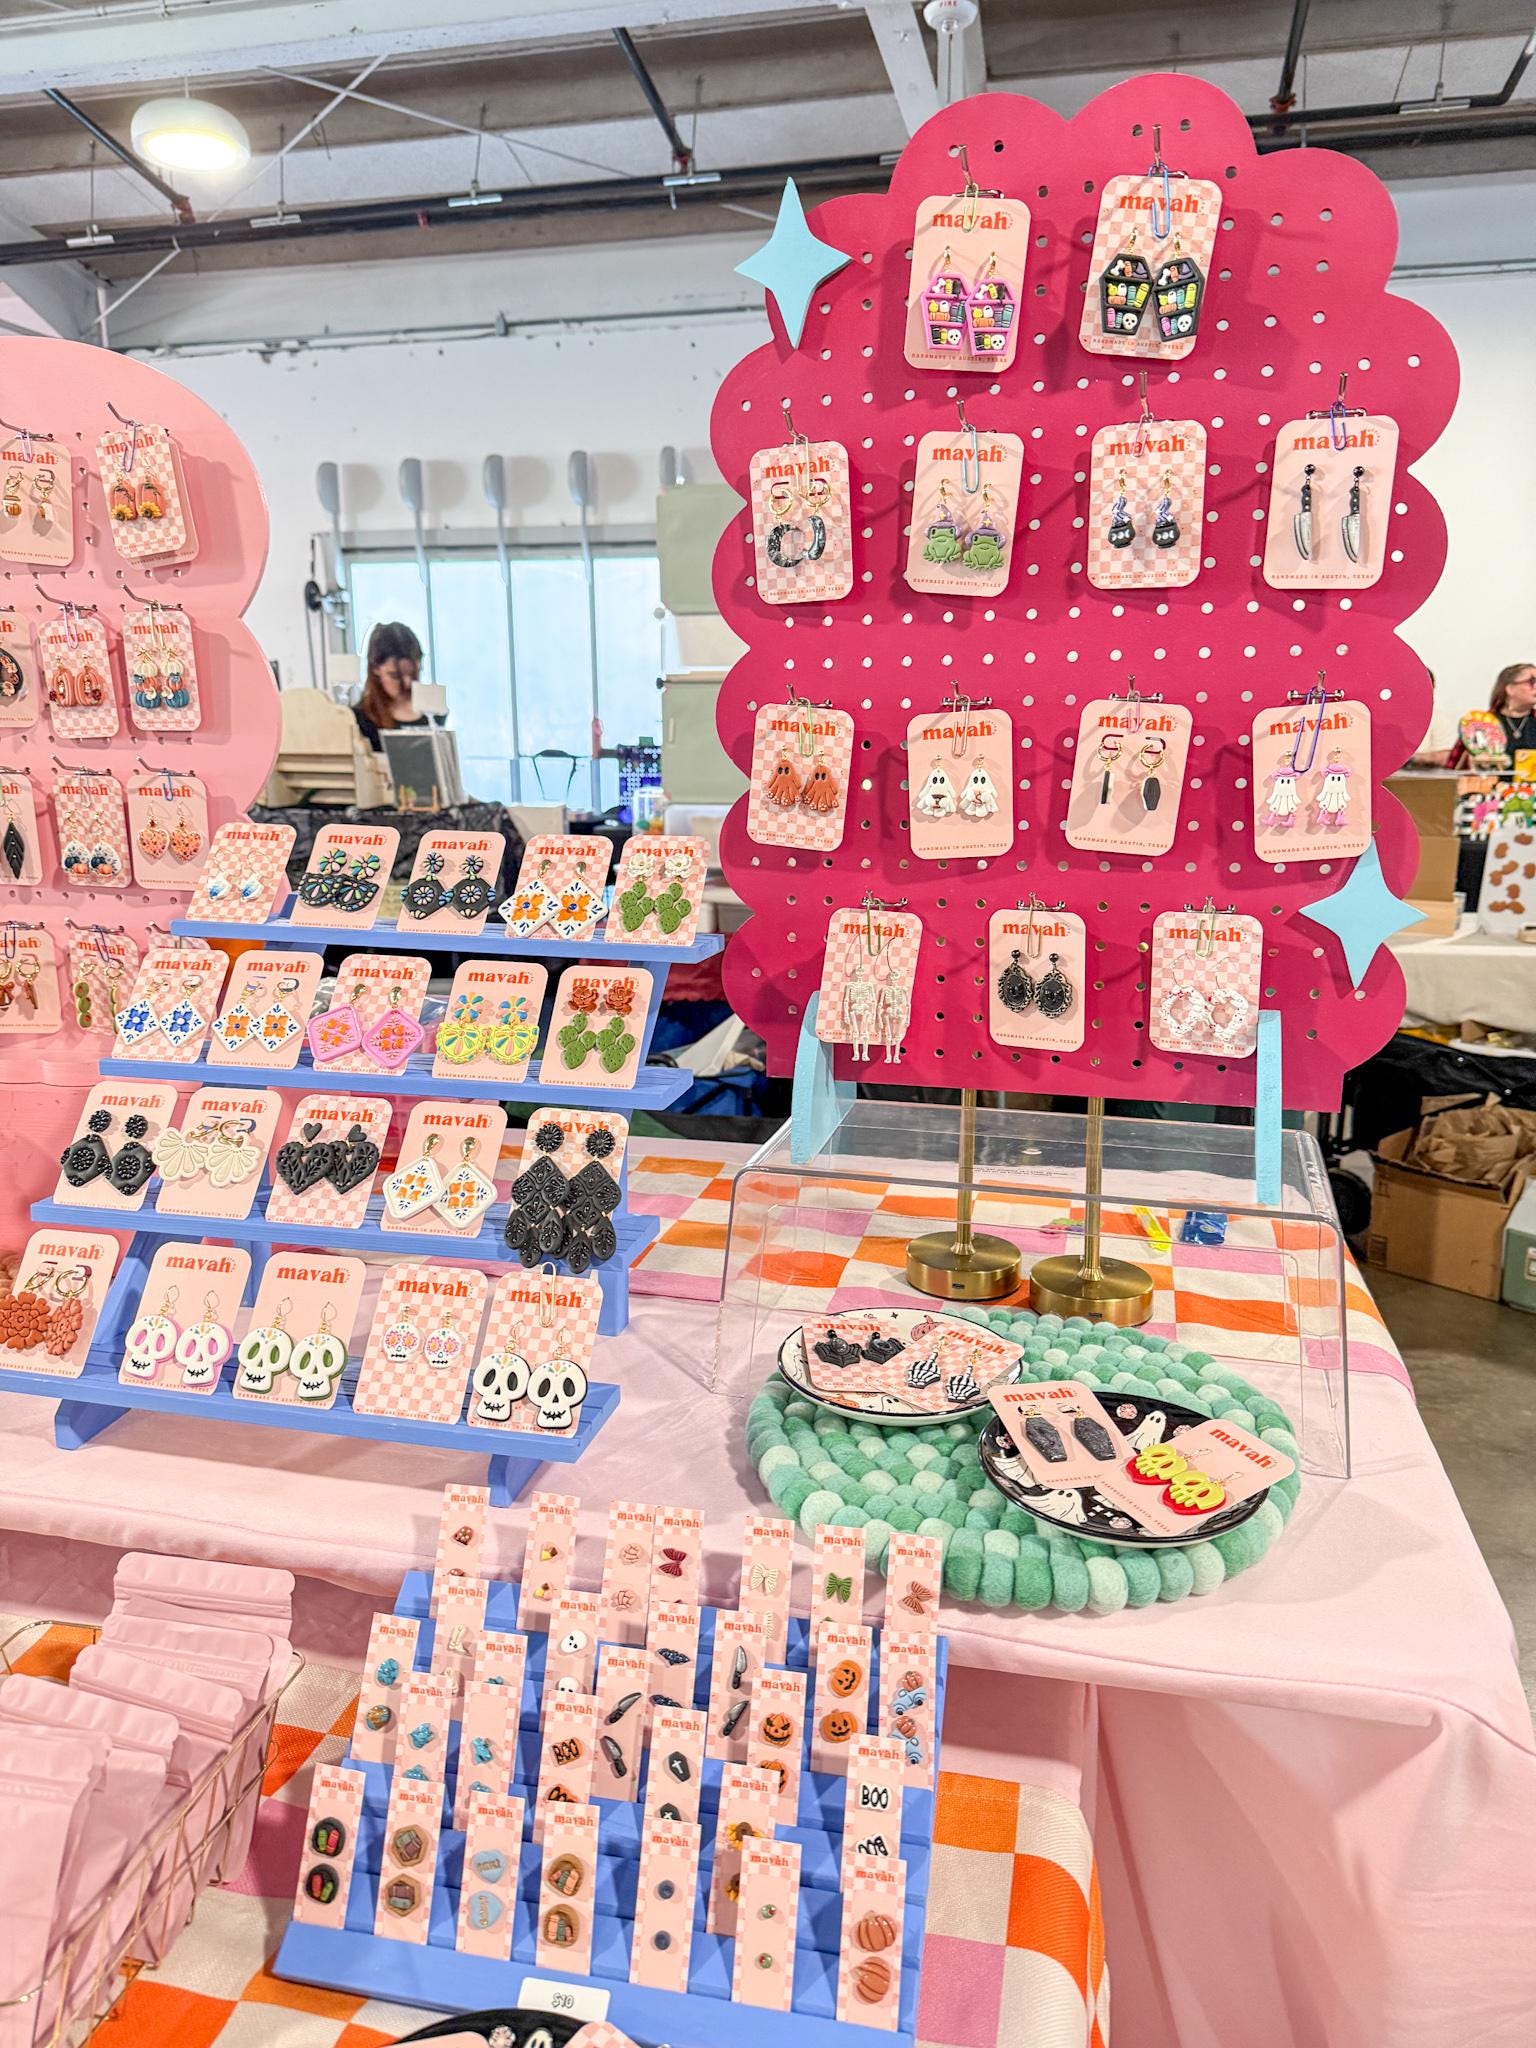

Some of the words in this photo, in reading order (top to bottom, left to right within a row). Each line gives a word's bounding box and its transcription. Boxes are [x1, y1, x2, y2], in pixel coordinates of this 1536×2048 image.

[1118, 194, 1199, 213] mavah
[931, 211, 1008, 230] mavah
[1109, 435, 1185, 455] mavah
[1293, 430, 1374, 450] mavah
[932, 445, 1002, 462] mavah
[771, 719, 836, 737] mavah
[922, 721, 992, 741] mavah
[1269, 713, 1348, 735] mavah
[225, 830, 280, 842] mavah
[328, 834, 383, 846] mavah
[431, 839, 489, 851] mavah
[538, 846, 597, 857] mavah
[1002, 922, 1066, 937] mavah
[1168, 927, 1241, 943] mavah
[155, 959, 212, 971] mavah
[247, 960, 306, 973] mavah
[353, 967, 413, 981] mavah
[467, 971, 529, 985] mavah
[101, 1094, 161, 1108] mavah
[201, 1100, 263, 1114] mavah
[309, 1108, 373, 1123] mavah
[423, 1114, 488, 1129] mavah
[38, 1244, 100, 1261] mavah
[167, 1256, 231, 1274] mavah
[277, 1267, 345, 1283] mavah
[398, 1280, 468, 1297] mavah
[510, 1289, 582, 1308] mavah
[816, 1322, 881, 1332] mavah
[947, 1329, 1006, 1356] mavah
[1003, 1388, 1073, 1403] mavah
[1210, 1428, 1272, 1468] mavah
[552, 1738, 580, 1765] BOO
[861, 1784, 889, 1809] BOO
[551, 1992, 575, 2009] $10
